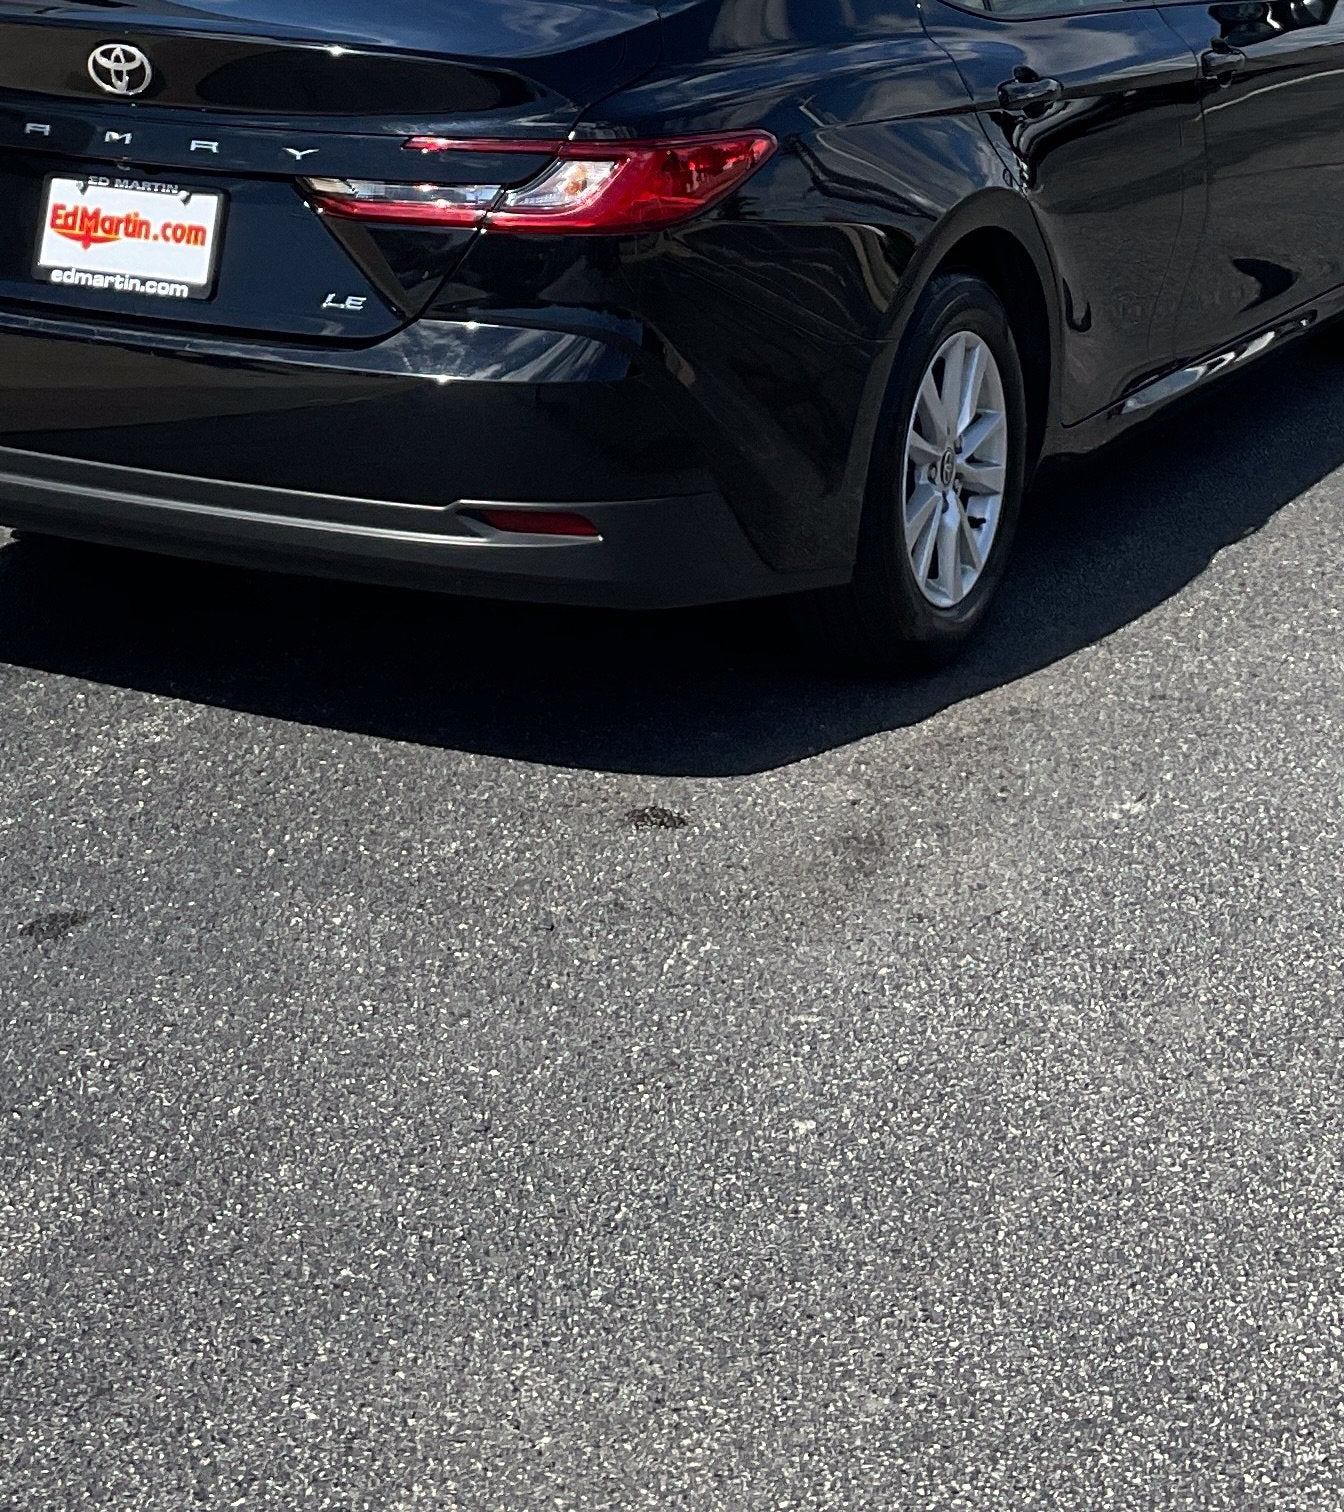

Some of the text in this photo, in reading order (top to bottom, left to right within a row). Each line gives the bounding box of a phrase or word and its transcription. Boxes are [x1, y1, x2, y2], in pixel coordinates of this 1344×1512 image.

[88, 175, 179, 194] ED MARTIN
[50, 268, 189, 298] edmartin.com
[322, 293, 367, 311] LE
